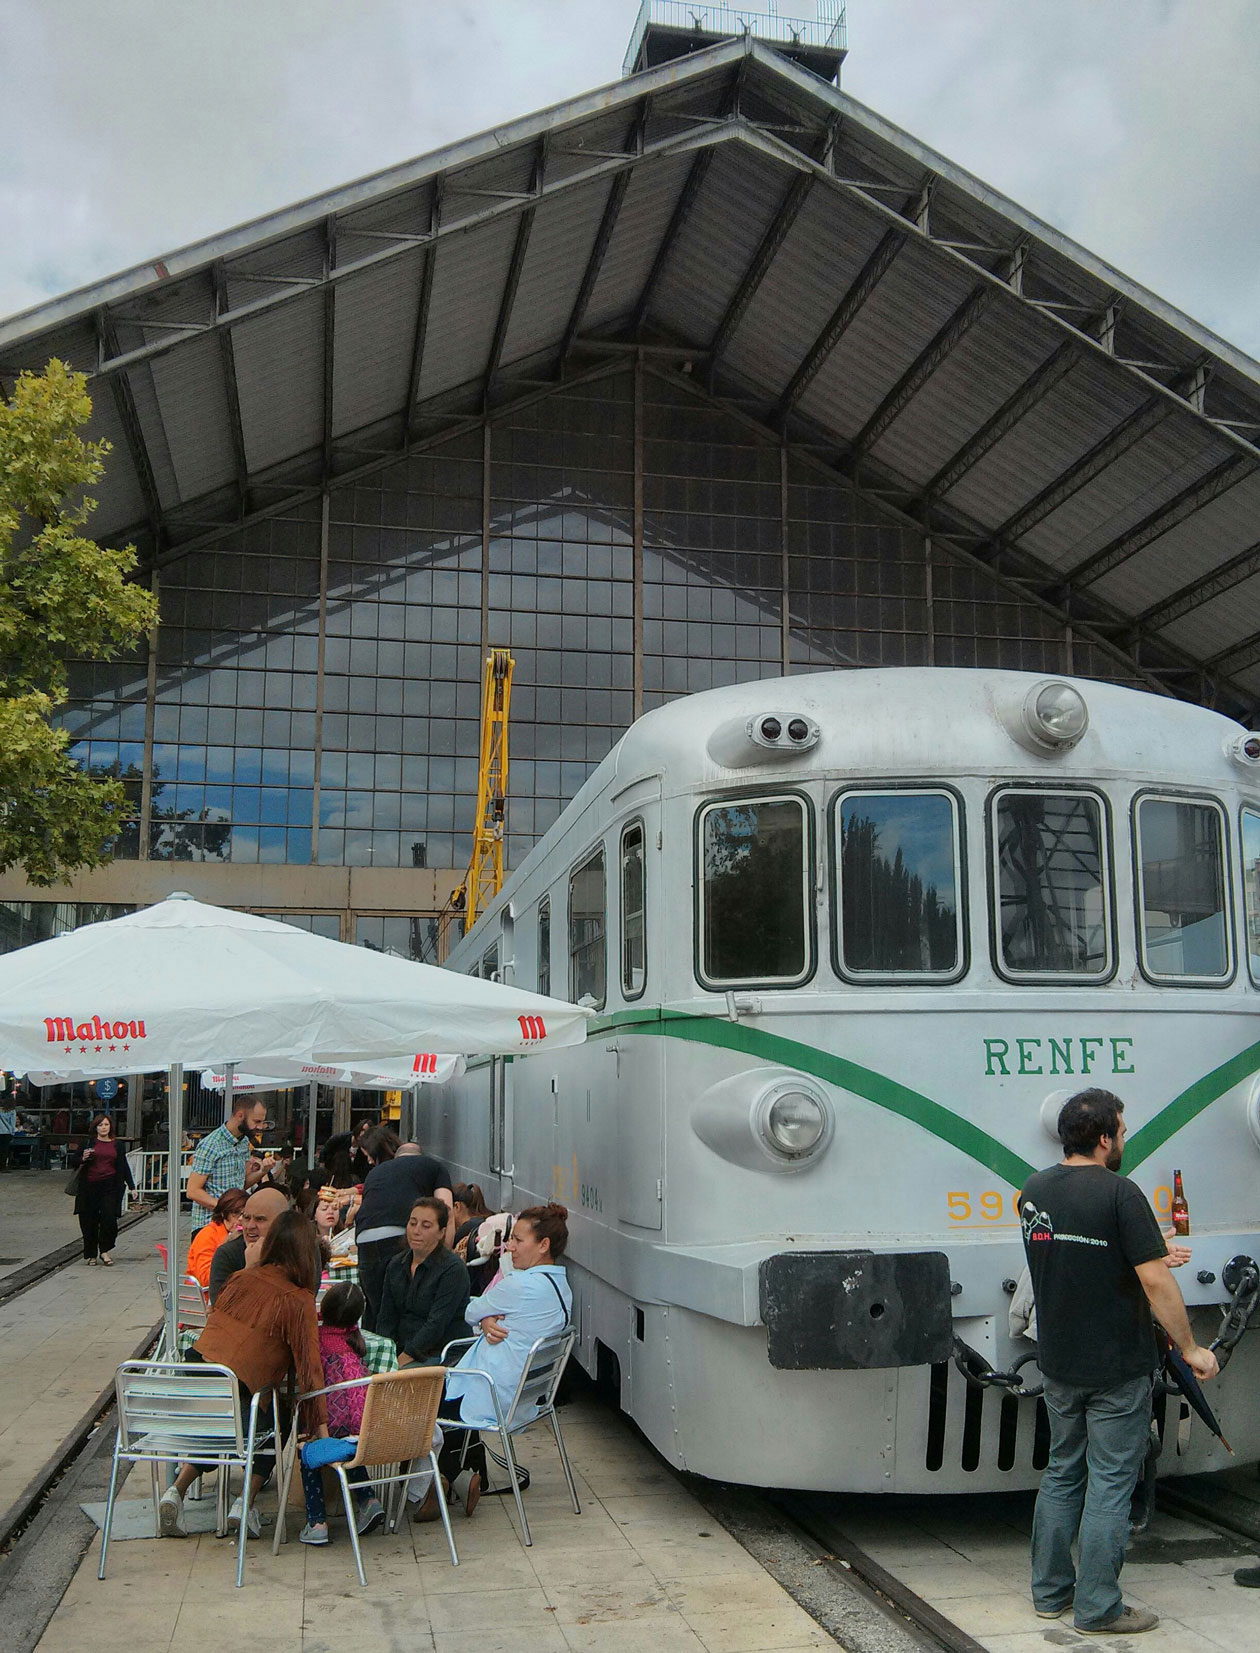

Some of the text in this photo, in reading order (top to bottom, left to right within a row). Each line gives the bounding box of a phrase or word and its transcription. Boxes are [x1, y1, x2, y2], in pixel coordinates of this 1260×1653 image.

[43, 1015, 147, 1042] Mahou
[983, 1037, 1135, 1075] RENFE
[1090, 1238, 1108, 1247] 2010
